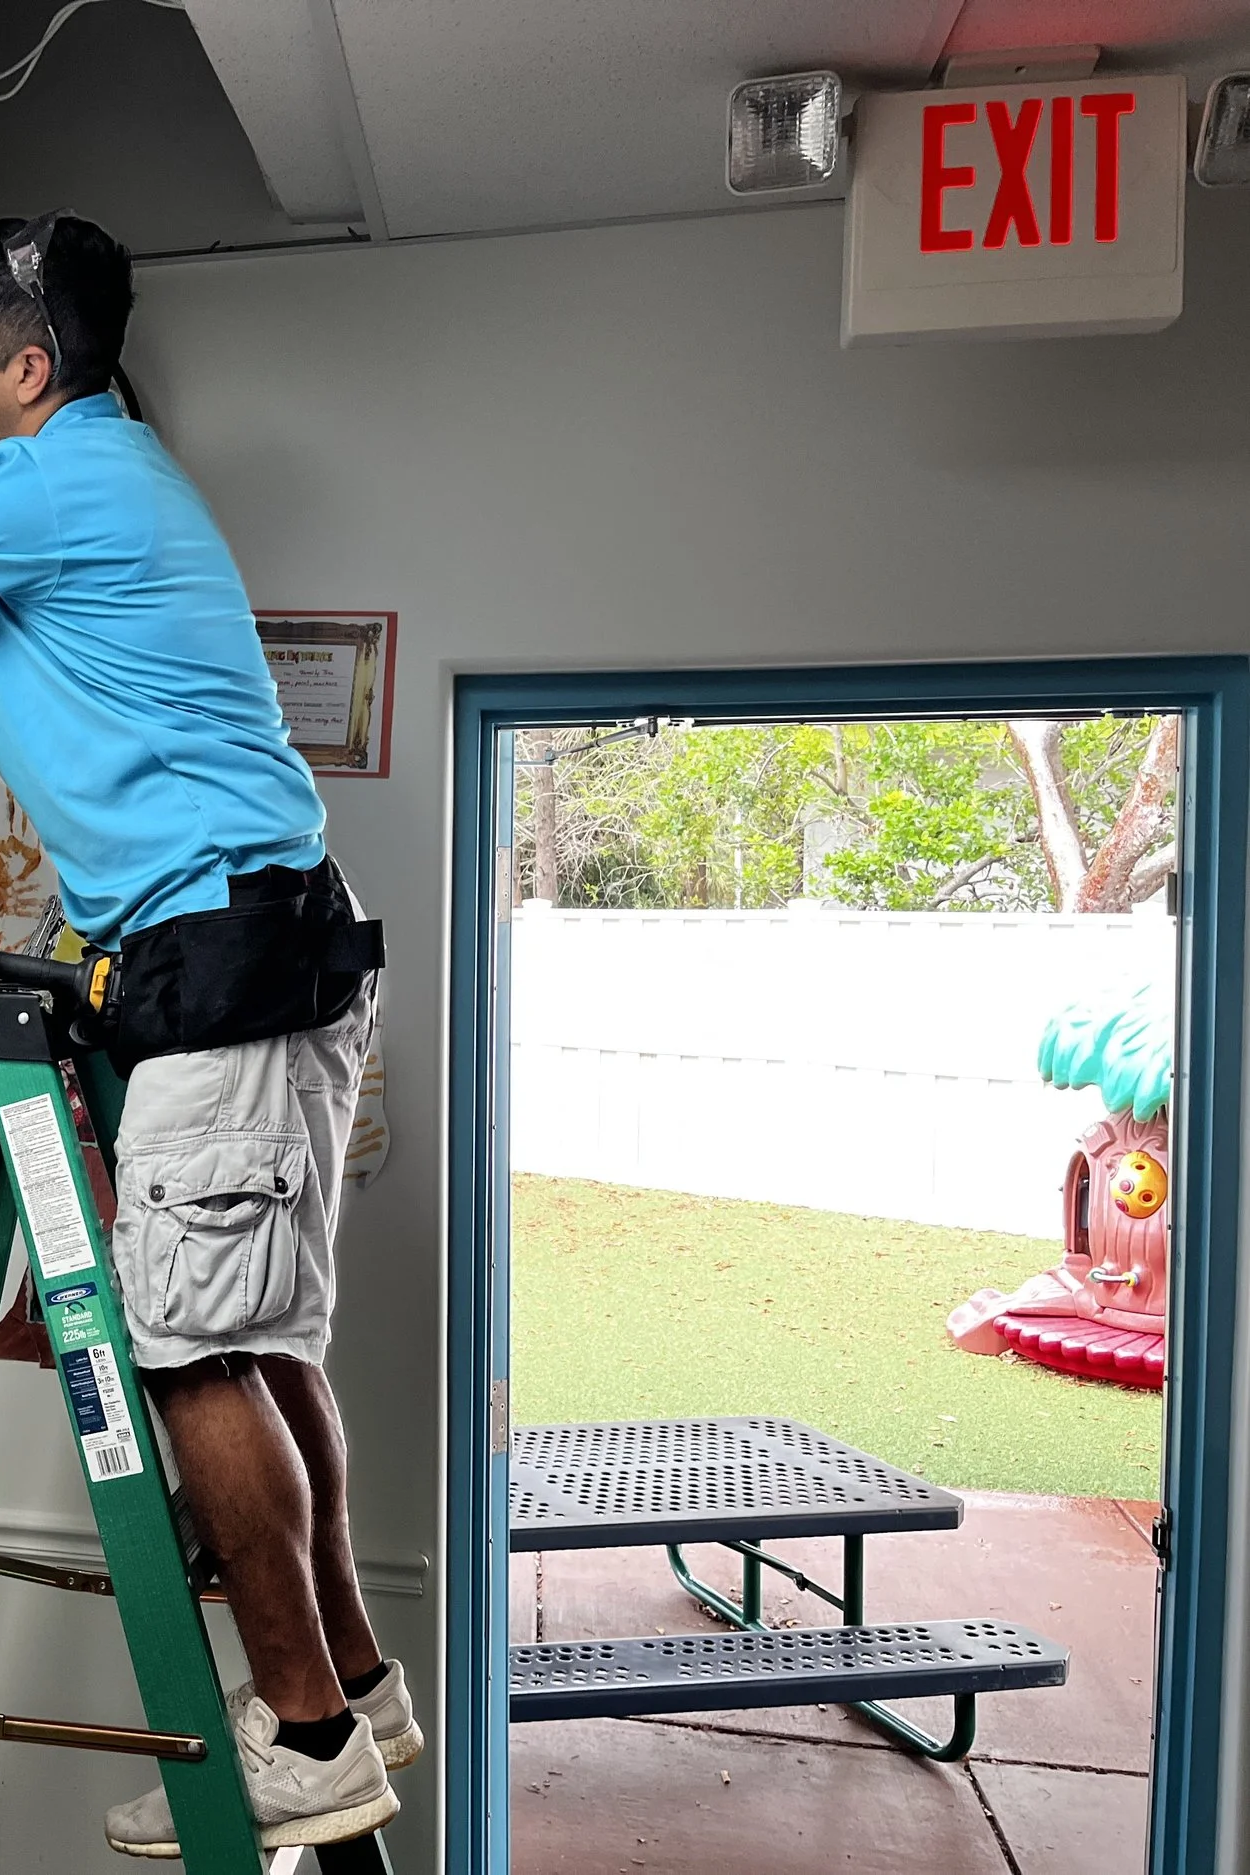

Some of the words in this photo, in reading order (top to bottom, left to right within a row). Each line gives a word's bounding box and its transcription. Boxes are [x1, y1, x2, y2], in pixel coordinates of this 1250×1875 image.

[920, 93, 1136, 254] EXIT
[61, 1311, 93, 1324] STANDARD
[62, 1328, 87, 1343] 225lb
[92, 1348, 105, 1359] 6ft
